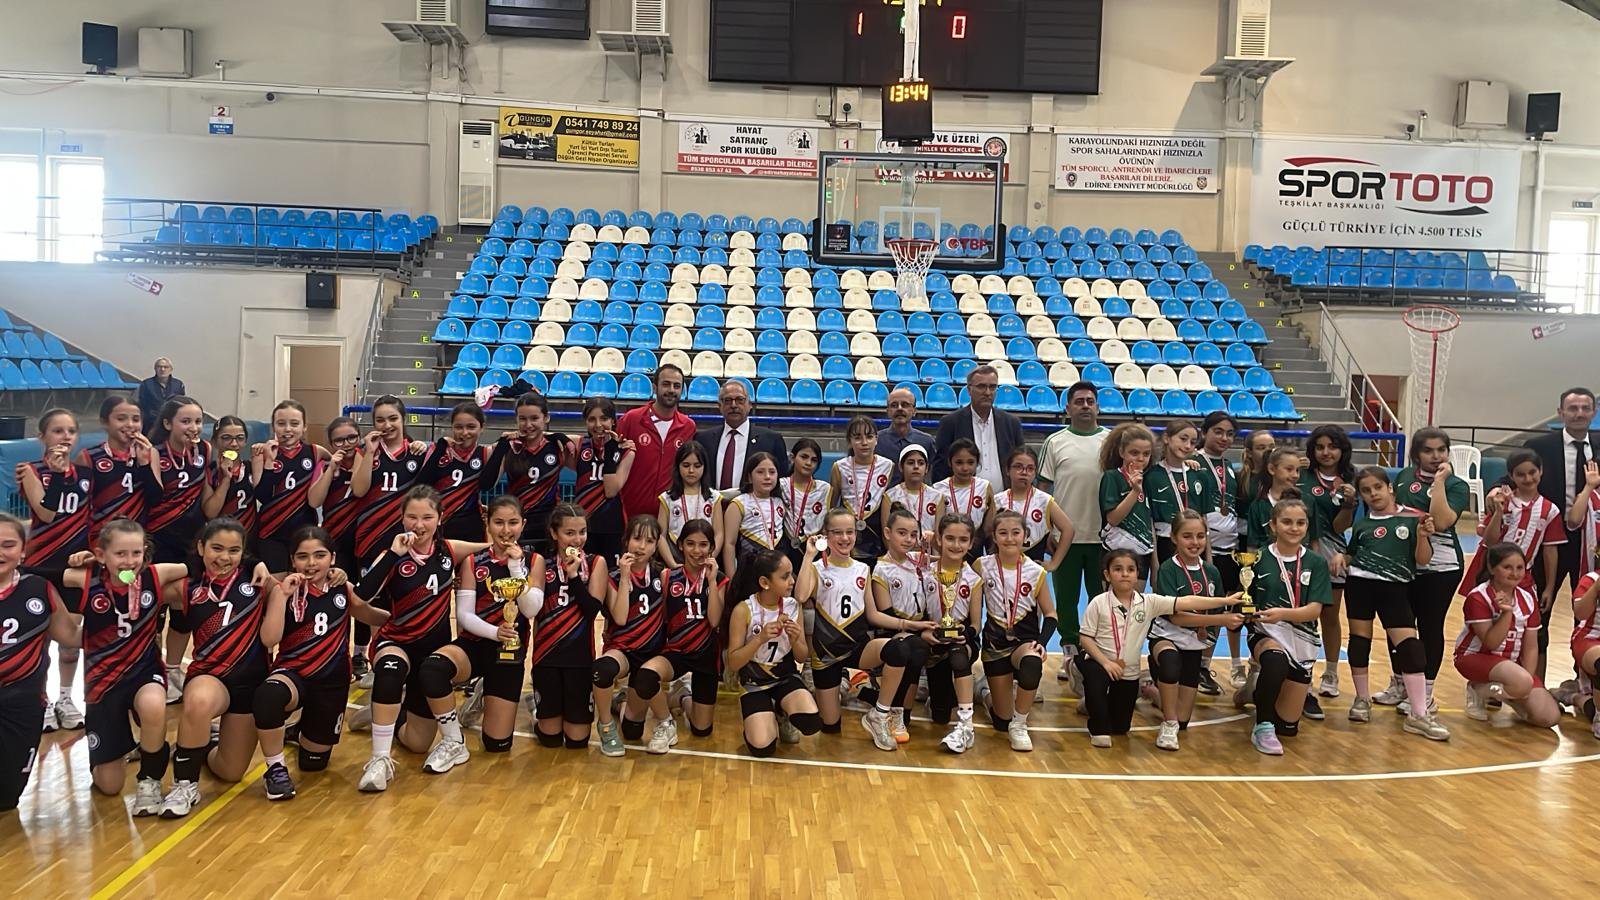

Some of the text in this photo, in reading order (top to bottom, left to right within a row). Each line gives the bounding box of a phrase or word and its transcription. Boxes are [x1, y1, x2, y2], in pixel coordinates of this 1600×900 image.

[952, 16, 966, 39] 0
[889, 84, 929, 102] 13:44
[217, 106, 226, 117] 2
[565, 118, 639, 132] 0541 749 89 24
[736, 126, 763, 135] HAYAT
[730, 135, 769, 146] SATRANÇ
[843, 139, 850, 149] 1
[936, 134, 949, 143] VE
[951, 132, 980, 145] ÜZERİ
[1069, 137, 1206, 149] KARAYOLUNDAKİ HIZINIZLA DEĞİL
[720, 145, 777, 156] SPOR KULÜBÜ
[1070, 146, 1203, 158] SPOR SAHALARINDAKİ HIZINIZLA
[603, 157, 638, 166] Organizasyon
[683, 154, 699, 163] TÜM
[700, 155, 746, 165] SPORCULARA
[747, 157, 785, 167] BAŞARILAR
[1061, 164, 1077, 172] TÜM
[1111, 165, 1152, 175] ANTRENÖR
[1164, 166, 1213, 175] İDARECİLERE
[1118, 156, 1155, 166] ÖVÜNÜN
[1084, 180, 1195, 191] EDİRNE EMNİYET MÜDÜRLÜĞÜ
[1100, 173, 1140, 183] BAŞARILAR
[1279, 200, 1385, 211] TEŞKİLAT BAŞKANLIĞI
[1282, 218, 1482, 239] GÜÇLÜ TÜRKİYE İÇİN 4.500 TESİS
[408, 386, 417, 395] C
[410, 414, 418, 423] B
[121, 471, 134, 494] 4
[176, 470, 190, 489] 2
[285, 471, 297, 490] 6
[380, 471, 399, 492] 11
[451, 468, 464, 487] 9
[526, 466, 541, 484] 9
[58, 491, 80, 514] 10
[236, 489, 248, 510] 2
[425, 573, 439, 596] 4
[557, 585, 570, 607] 5
[638, 593, 651, 615] 3
[217, 600, 235, 627] 7
[684, 598, 705, 619] 11
[840, 594, 852, 619] 6
[2, 617, 20, 644] 2
[117, 611, 133, 638] 5
[313, 611, 330, 637] 8
[768, 641, 779, 663] 7
